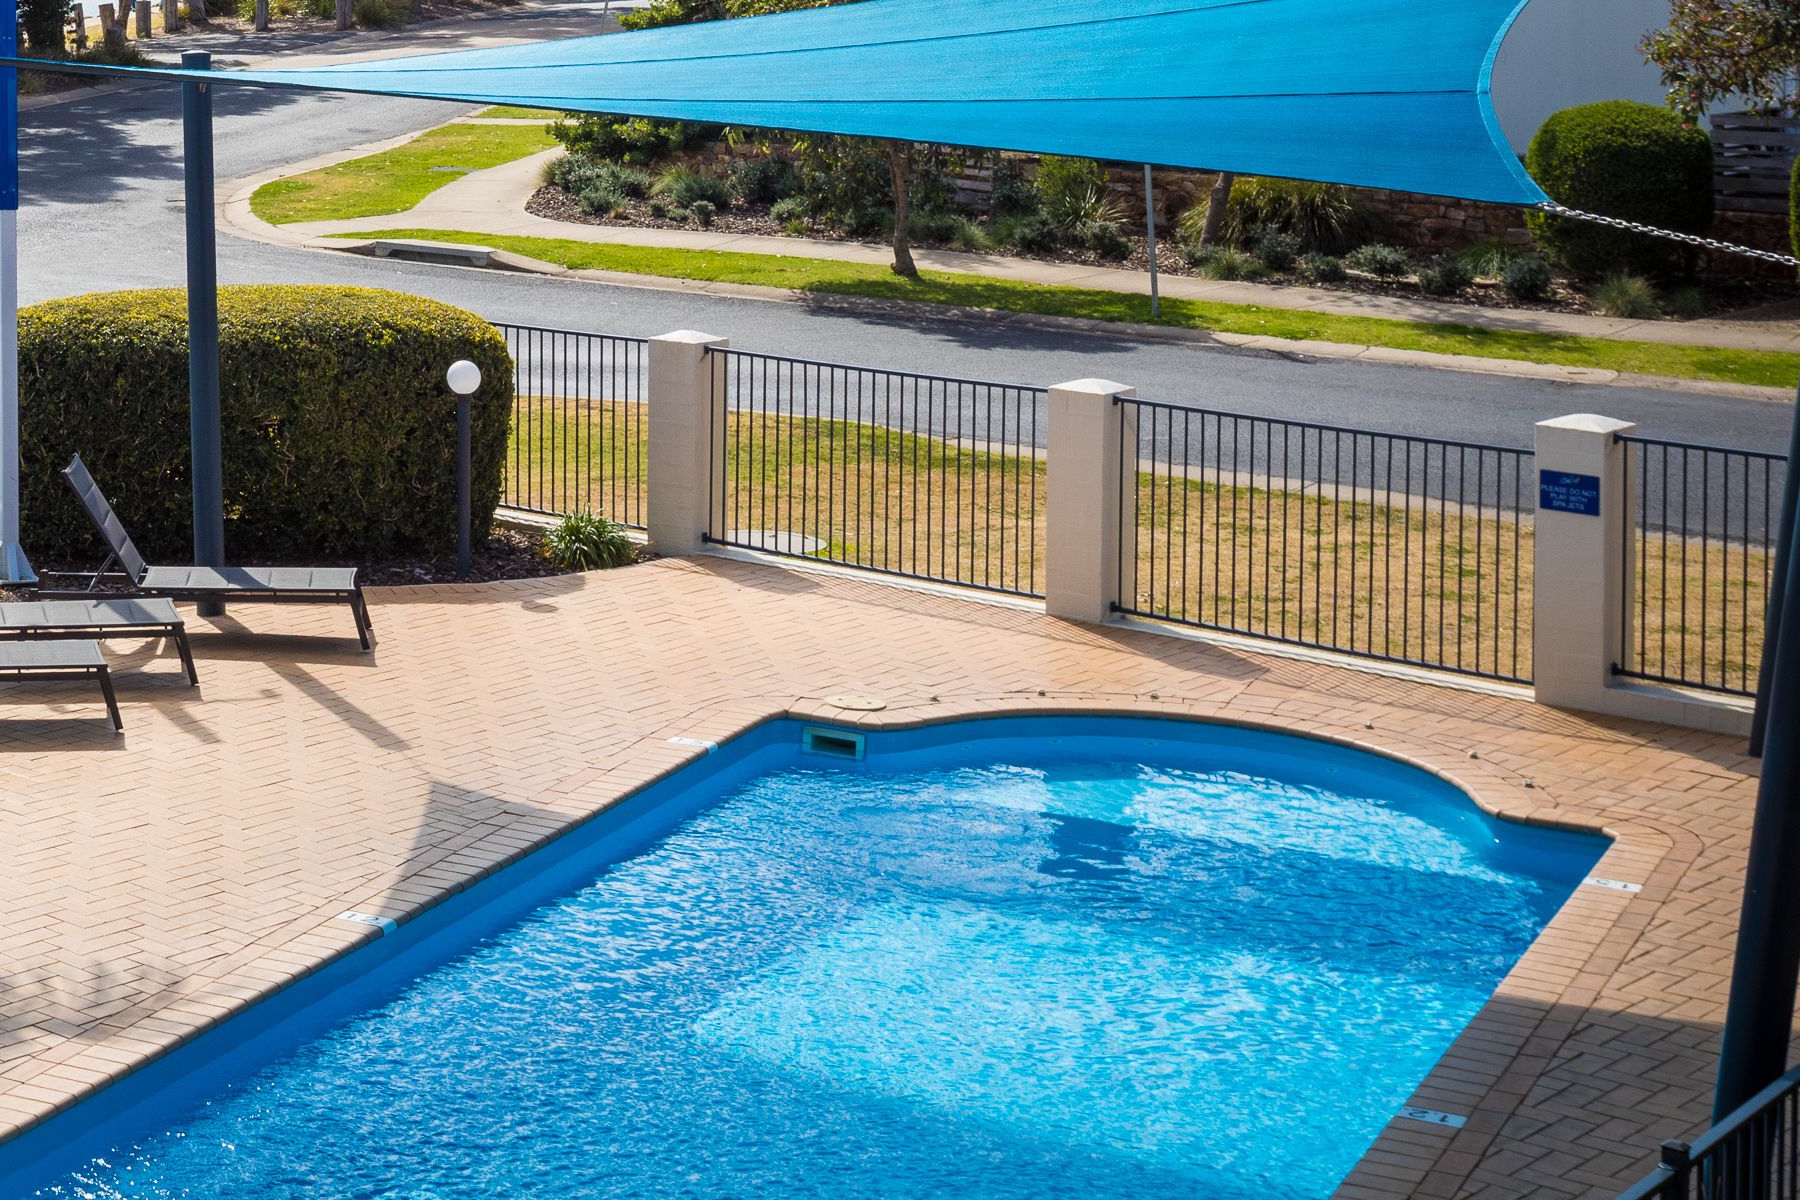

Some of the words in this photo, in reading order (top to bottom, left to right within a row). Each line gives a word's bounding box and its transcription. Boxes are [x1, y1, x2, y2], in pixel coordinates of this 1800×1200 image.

[1540, 484, 1569, 494] PLEASE
[1569, 488, 1581, 496] DO
[1581, 489, 1597, 497] NOT
[1550, 492, 1567, 500] PLAY
